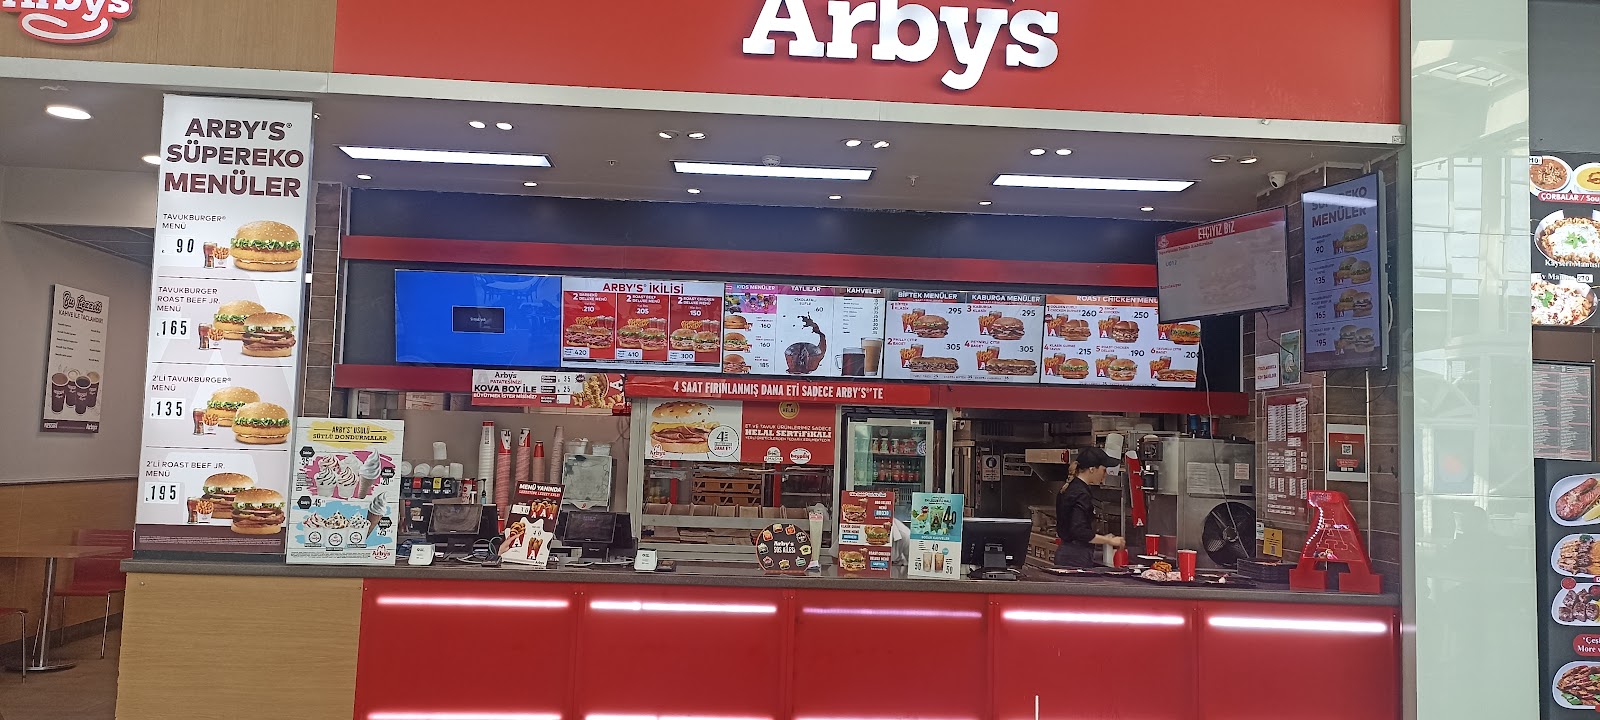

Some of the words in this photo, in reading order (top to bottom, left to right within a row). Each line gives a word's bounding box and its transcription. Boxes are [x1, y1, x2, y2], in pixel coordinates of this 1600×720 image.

[165, 139, 304, 168] SÜPEREKO
[164, 169, 302, 198] MENÜLER
[1541, 193, 1579, 201] ÇORBALAR
[162, 222, 187, 230] MENÜ
[158, 286, 218, 295] TAVUKBURGER
[649, 282, 684, 294] İKİLİSİ
[157, 295, 184, 303] ROAST
[186, 296, 207, 304] BEEF
[923, 291, 958, 300] MENÜLER
[972, 294, 1005, 302] KABURGA
[1006, 295, 1041, 303] MENÜLER
[156, 305, 182, 313] MENÜ
[474, 384, 500, 392] KOVA
[502, 385, 521, 393] BOY
[523, 384, 537, 393] İLE
[673, 381, 679, 392] 4
[681, 382, 703, 393] SAAT
[705, 382, 759, 397] FIRINLANMIŞ
[761, 384, 784, 396] DANA
[786, 383, 799, 396] ETİ
[801, 385, 834, 398] SADECE
[776, 430, 832, 438] SERTİFİKALI
[162, 461, 189, 469] ROAST
[145, 470, 171, 478] MENÜ
[1577, 645, 1596, 653] More
